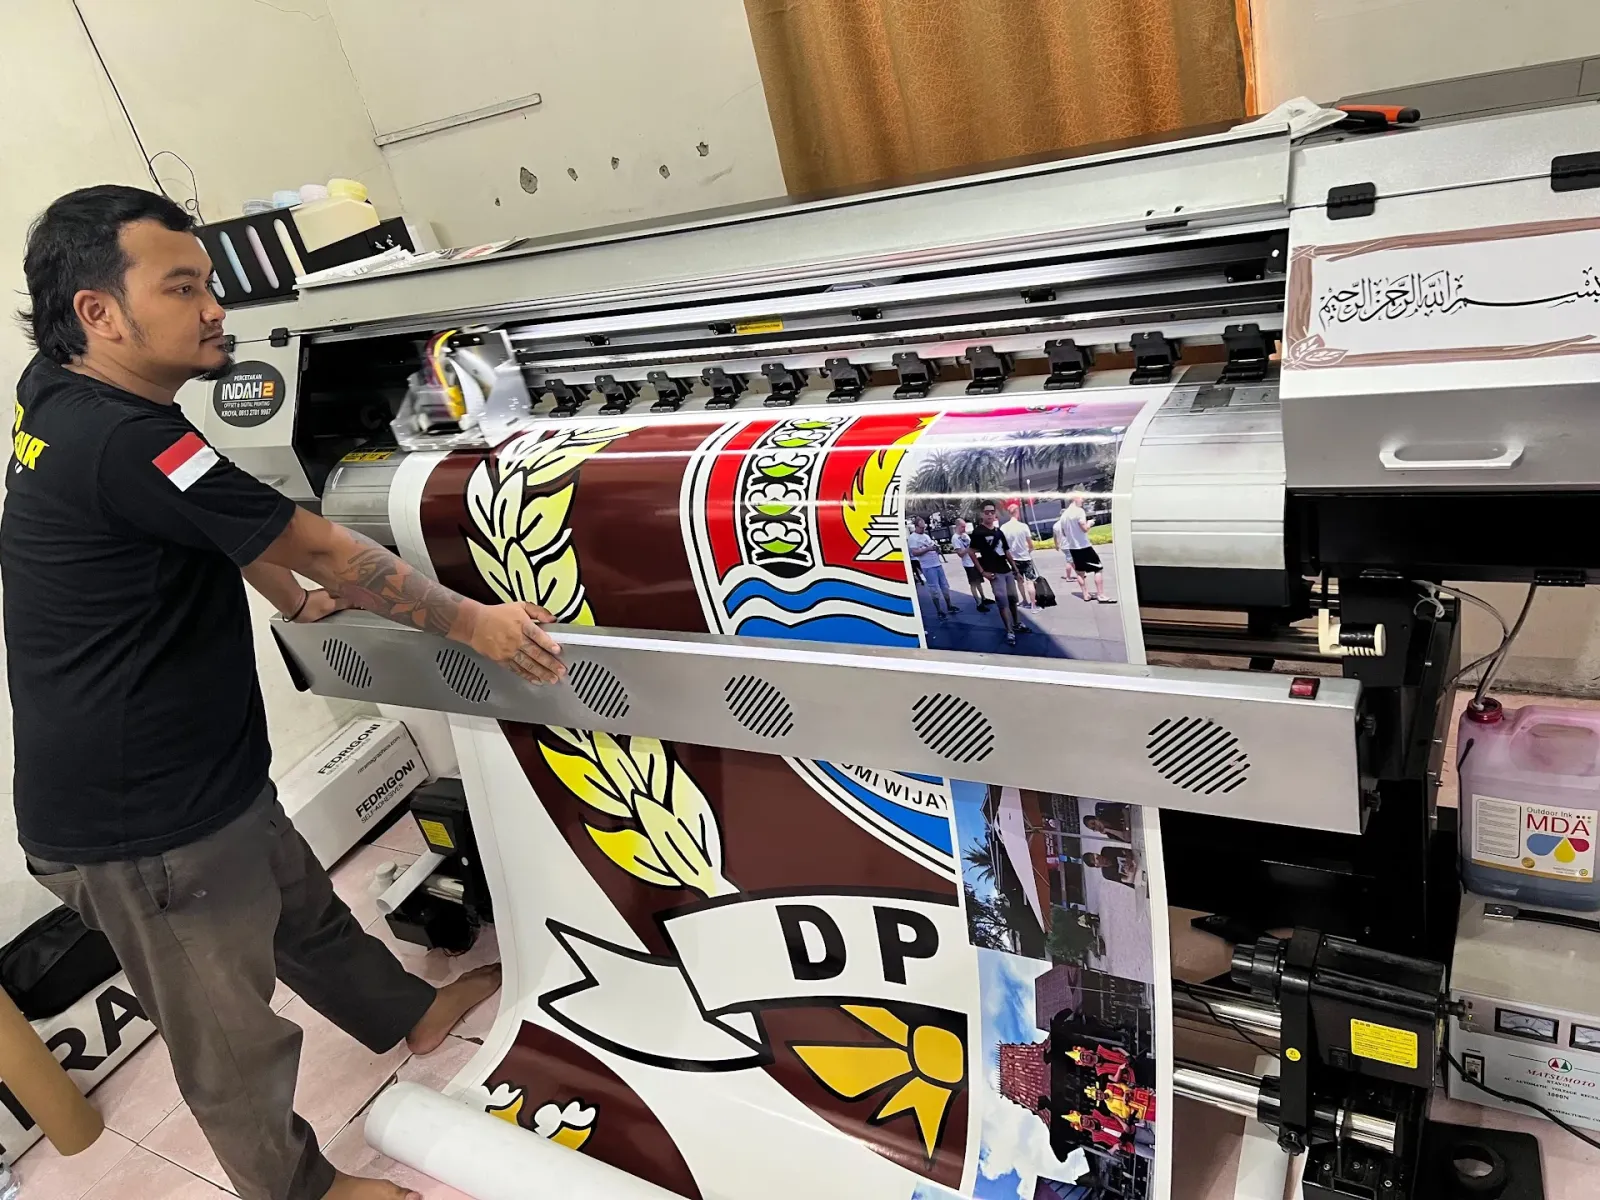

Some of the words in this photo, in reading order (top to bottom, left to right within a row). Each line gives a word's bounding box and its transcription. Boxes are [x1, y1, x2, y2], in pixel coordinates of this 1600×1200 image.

[318, 723, 381, 776] FEDRIGONI
[355, 759, 416, 818] FEDRIGONI
[361, 782, 404, 824] SELF-ADHESIVES
[1526, 806, 1559, 817] Outdoor
[1560, 811, 1573, 819] Ink
[1515, 1079, 1548, 1090] AUTOMATIC
[1551, 1086, 1578, 1096] VOLTAGE
[1526, 1069, 1596, 1089] MATSUMOTO
[1546, 1079, 1572, 1089] STAVOL
